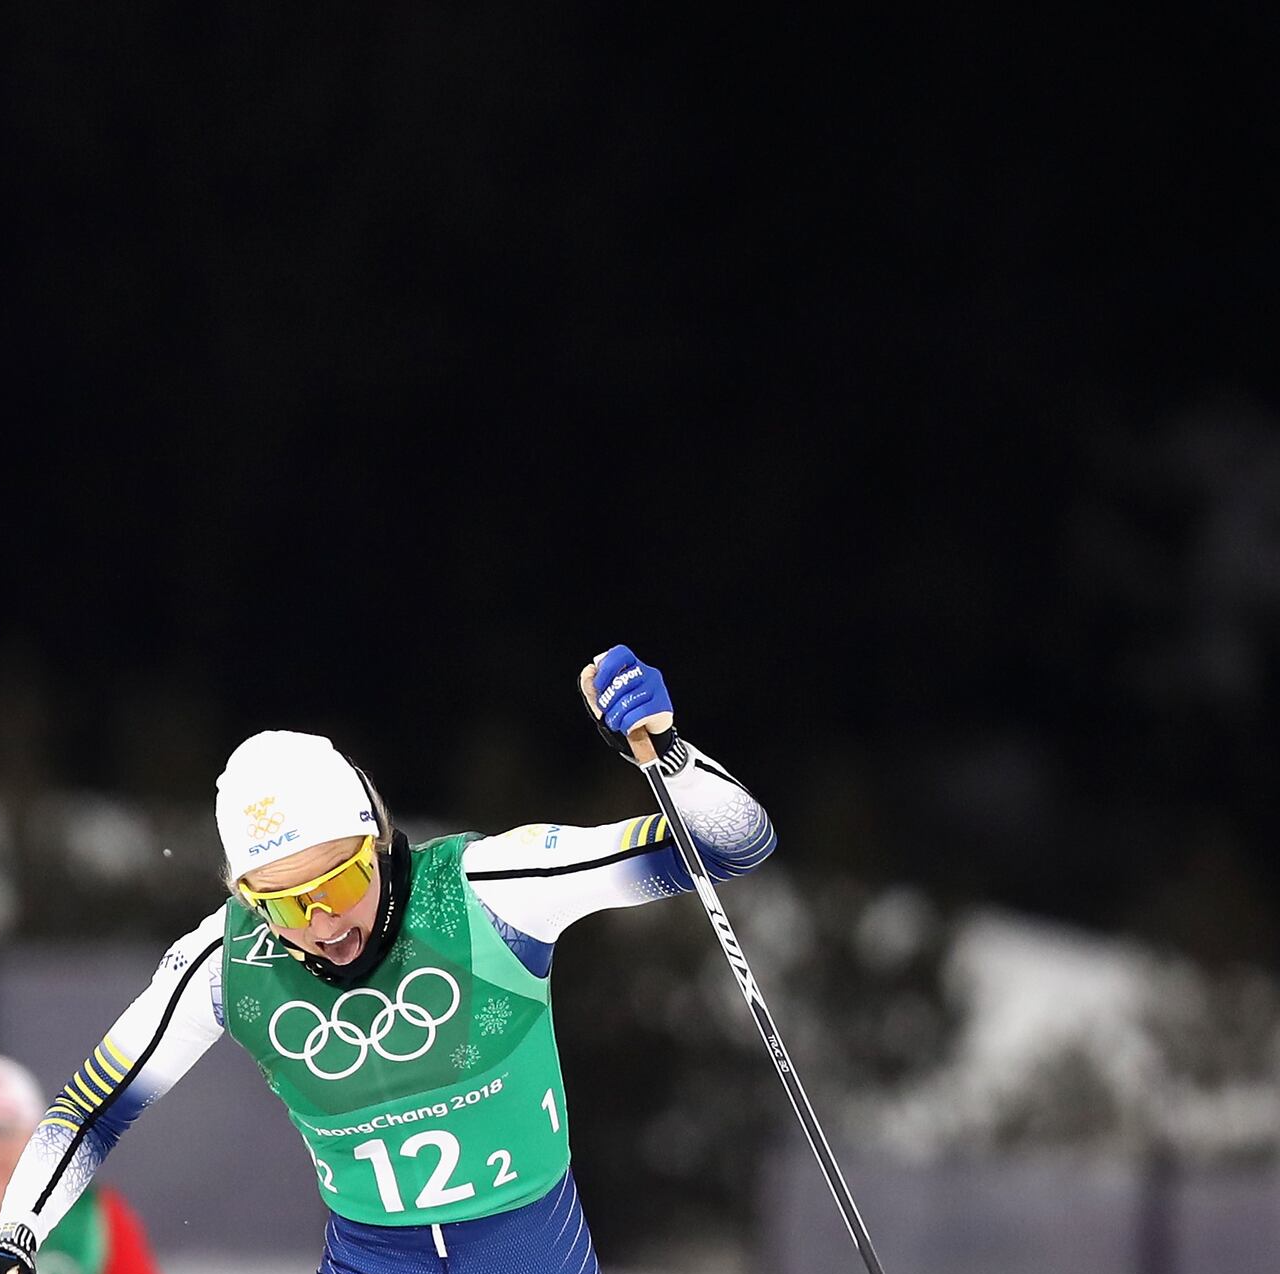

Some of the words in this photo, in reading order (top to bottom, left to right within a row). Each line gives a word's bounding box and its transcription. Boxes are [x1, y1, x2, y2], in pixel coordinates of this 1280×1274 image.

[248, 829, 301, 857] SWE
[449, 1078, 504, 1111] 2018
[353, 1129, 476, 1213] 12
[486, 1149, 518, 1188] 2
